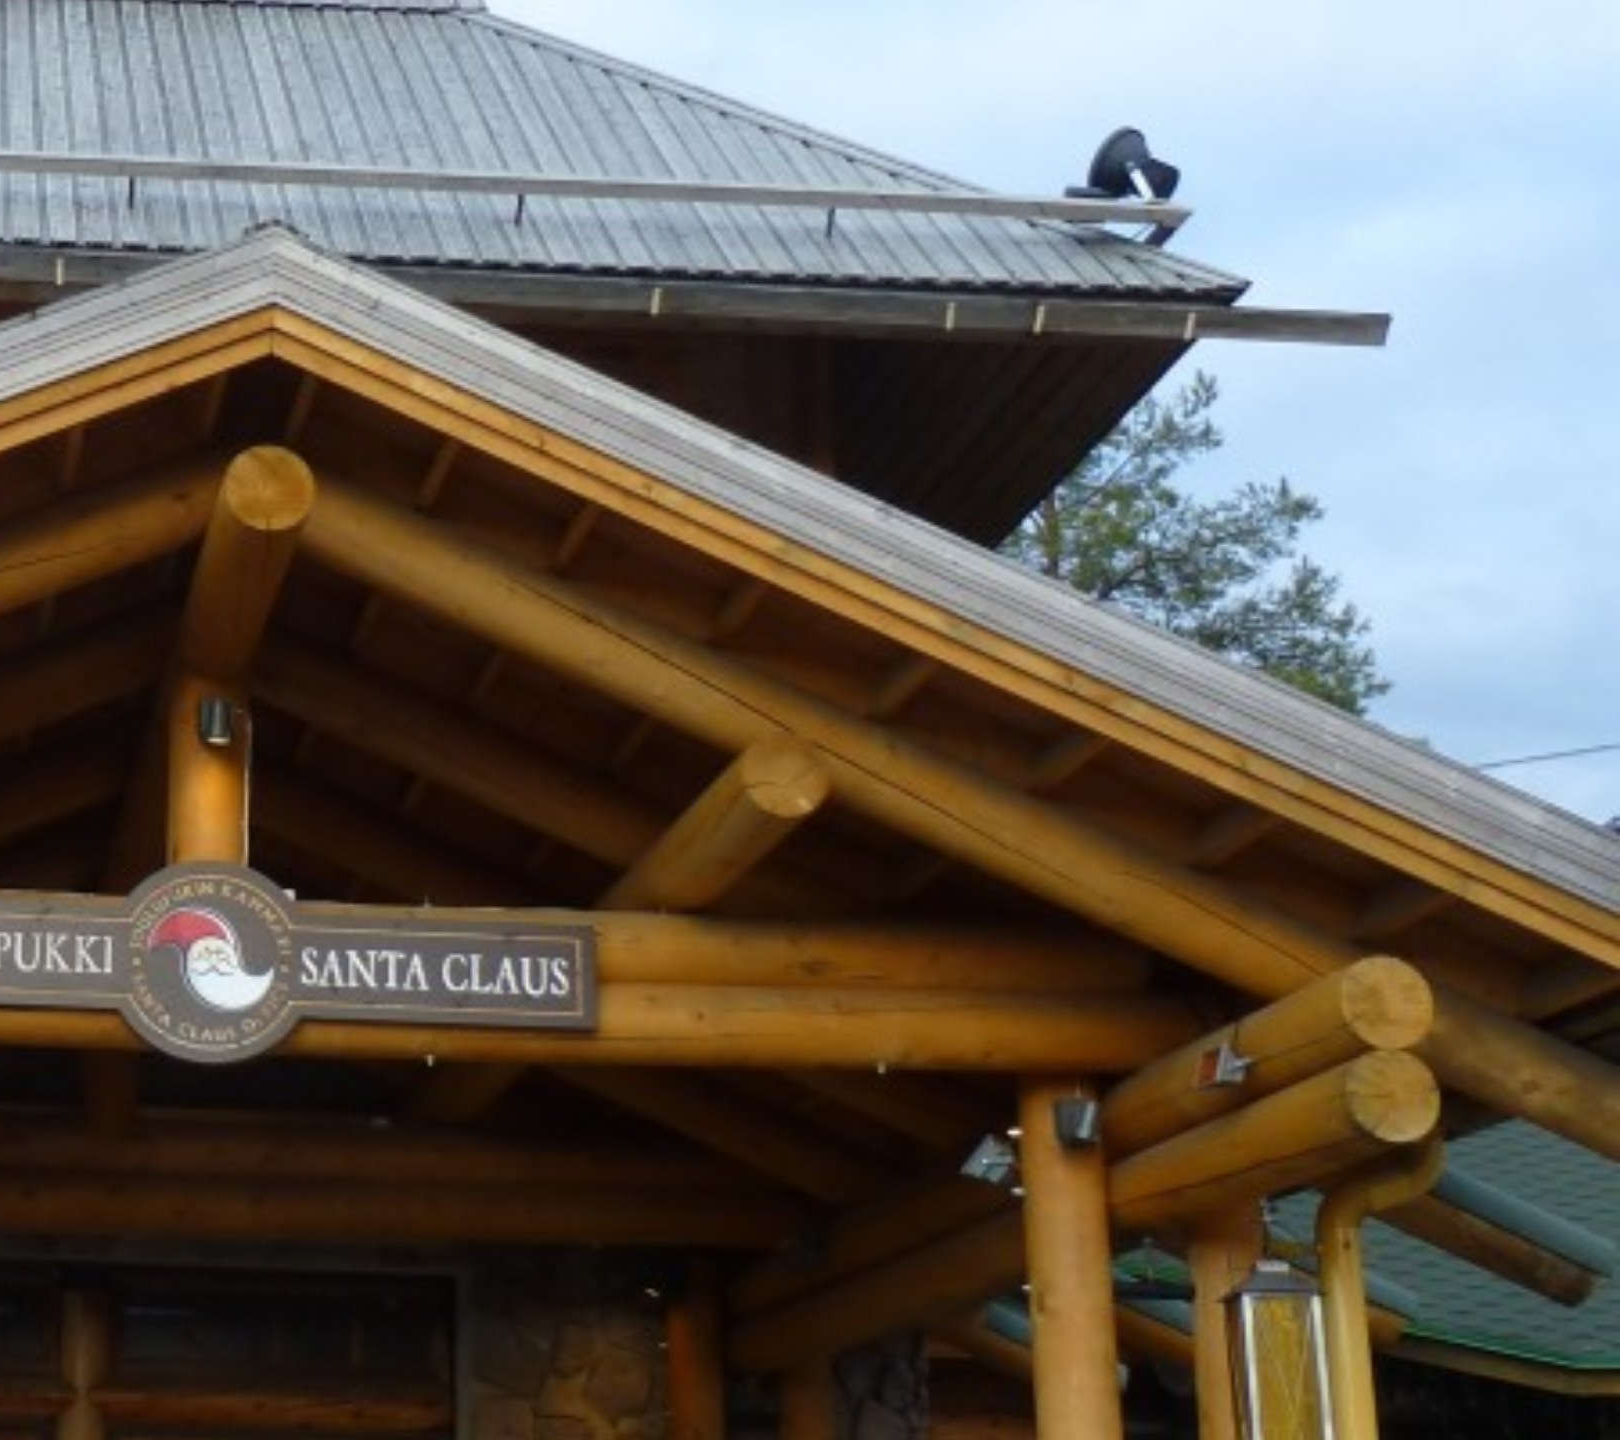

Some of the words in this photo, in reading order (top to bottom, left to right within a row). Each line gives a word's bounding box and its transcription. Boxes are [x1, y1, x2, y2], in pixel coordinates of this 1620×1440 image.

[300, 946, 430, 991] SANTA
[441, 953, 571, 997] CLAUS
[178, 1020, 237, 1042] CLAUS
